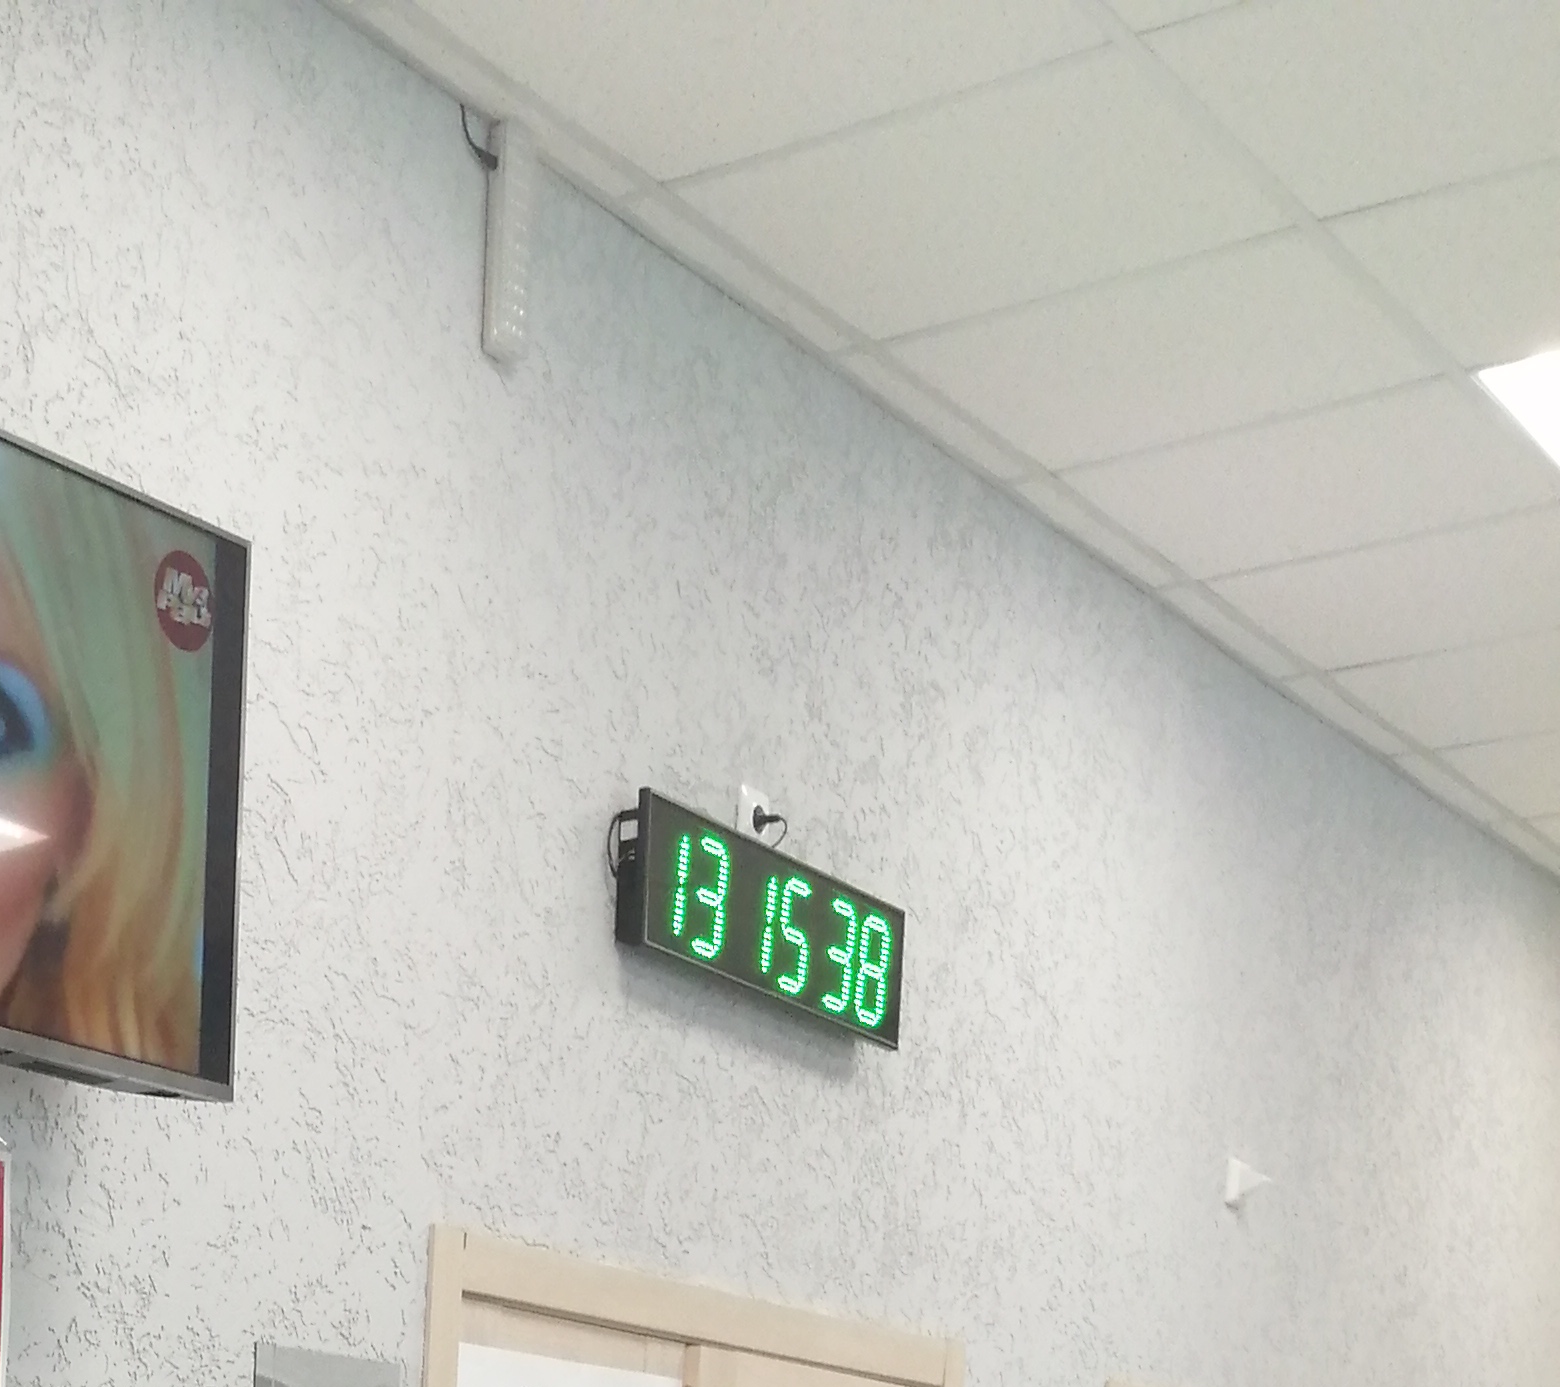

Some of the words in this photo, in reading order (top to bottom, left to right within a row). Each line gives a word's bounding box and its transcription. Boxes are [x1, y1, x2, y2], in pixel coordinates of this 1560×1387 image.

[672, 833, 730, 960] 13
[760, 875, 812, 994] 15
[822, 897, 891, 1028] 38
